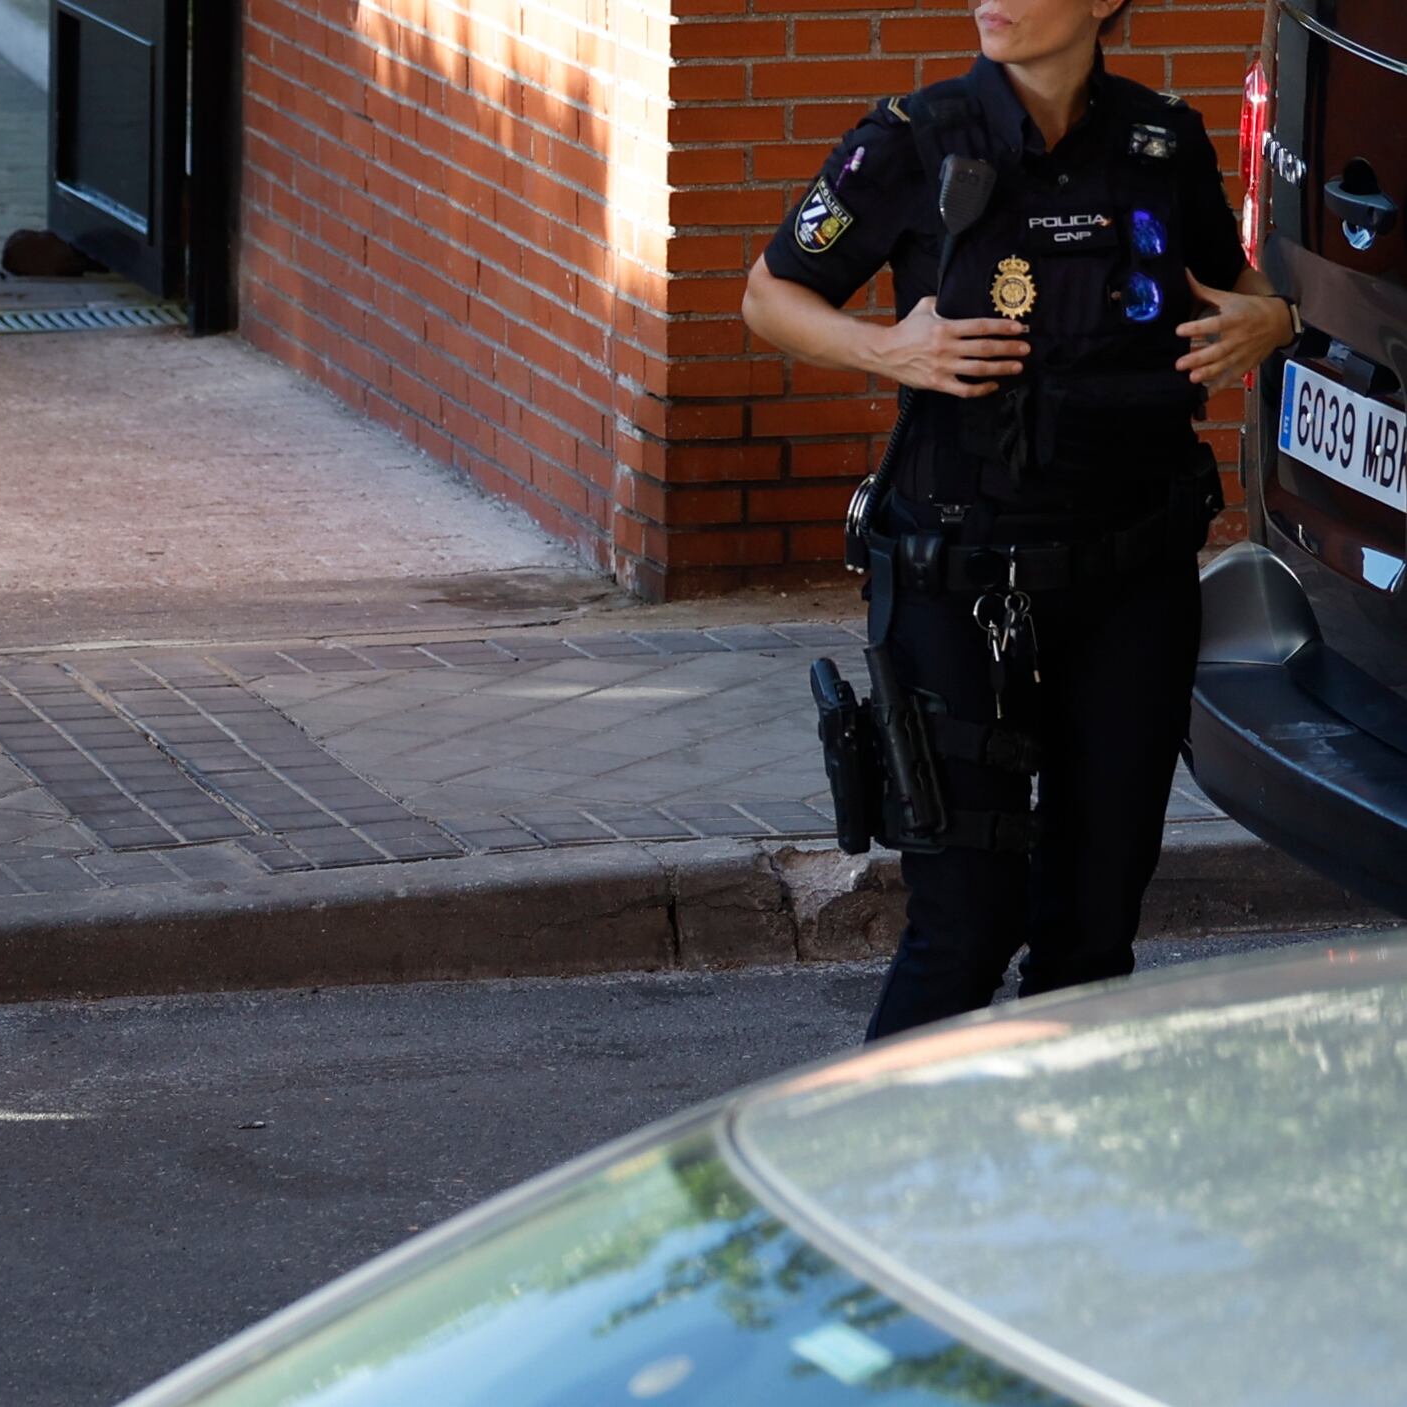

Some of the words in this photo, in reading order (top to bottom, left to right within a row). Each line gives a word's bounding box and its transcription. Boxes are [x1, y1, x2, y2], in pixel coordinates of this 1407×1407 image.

[820, 180, 848, 223] POLICIA
[1028, 214, 1107, 229] POLICIA
[1054, 231, 1091, 242] CNP
[1297, 381, 1355, 469] 6039
